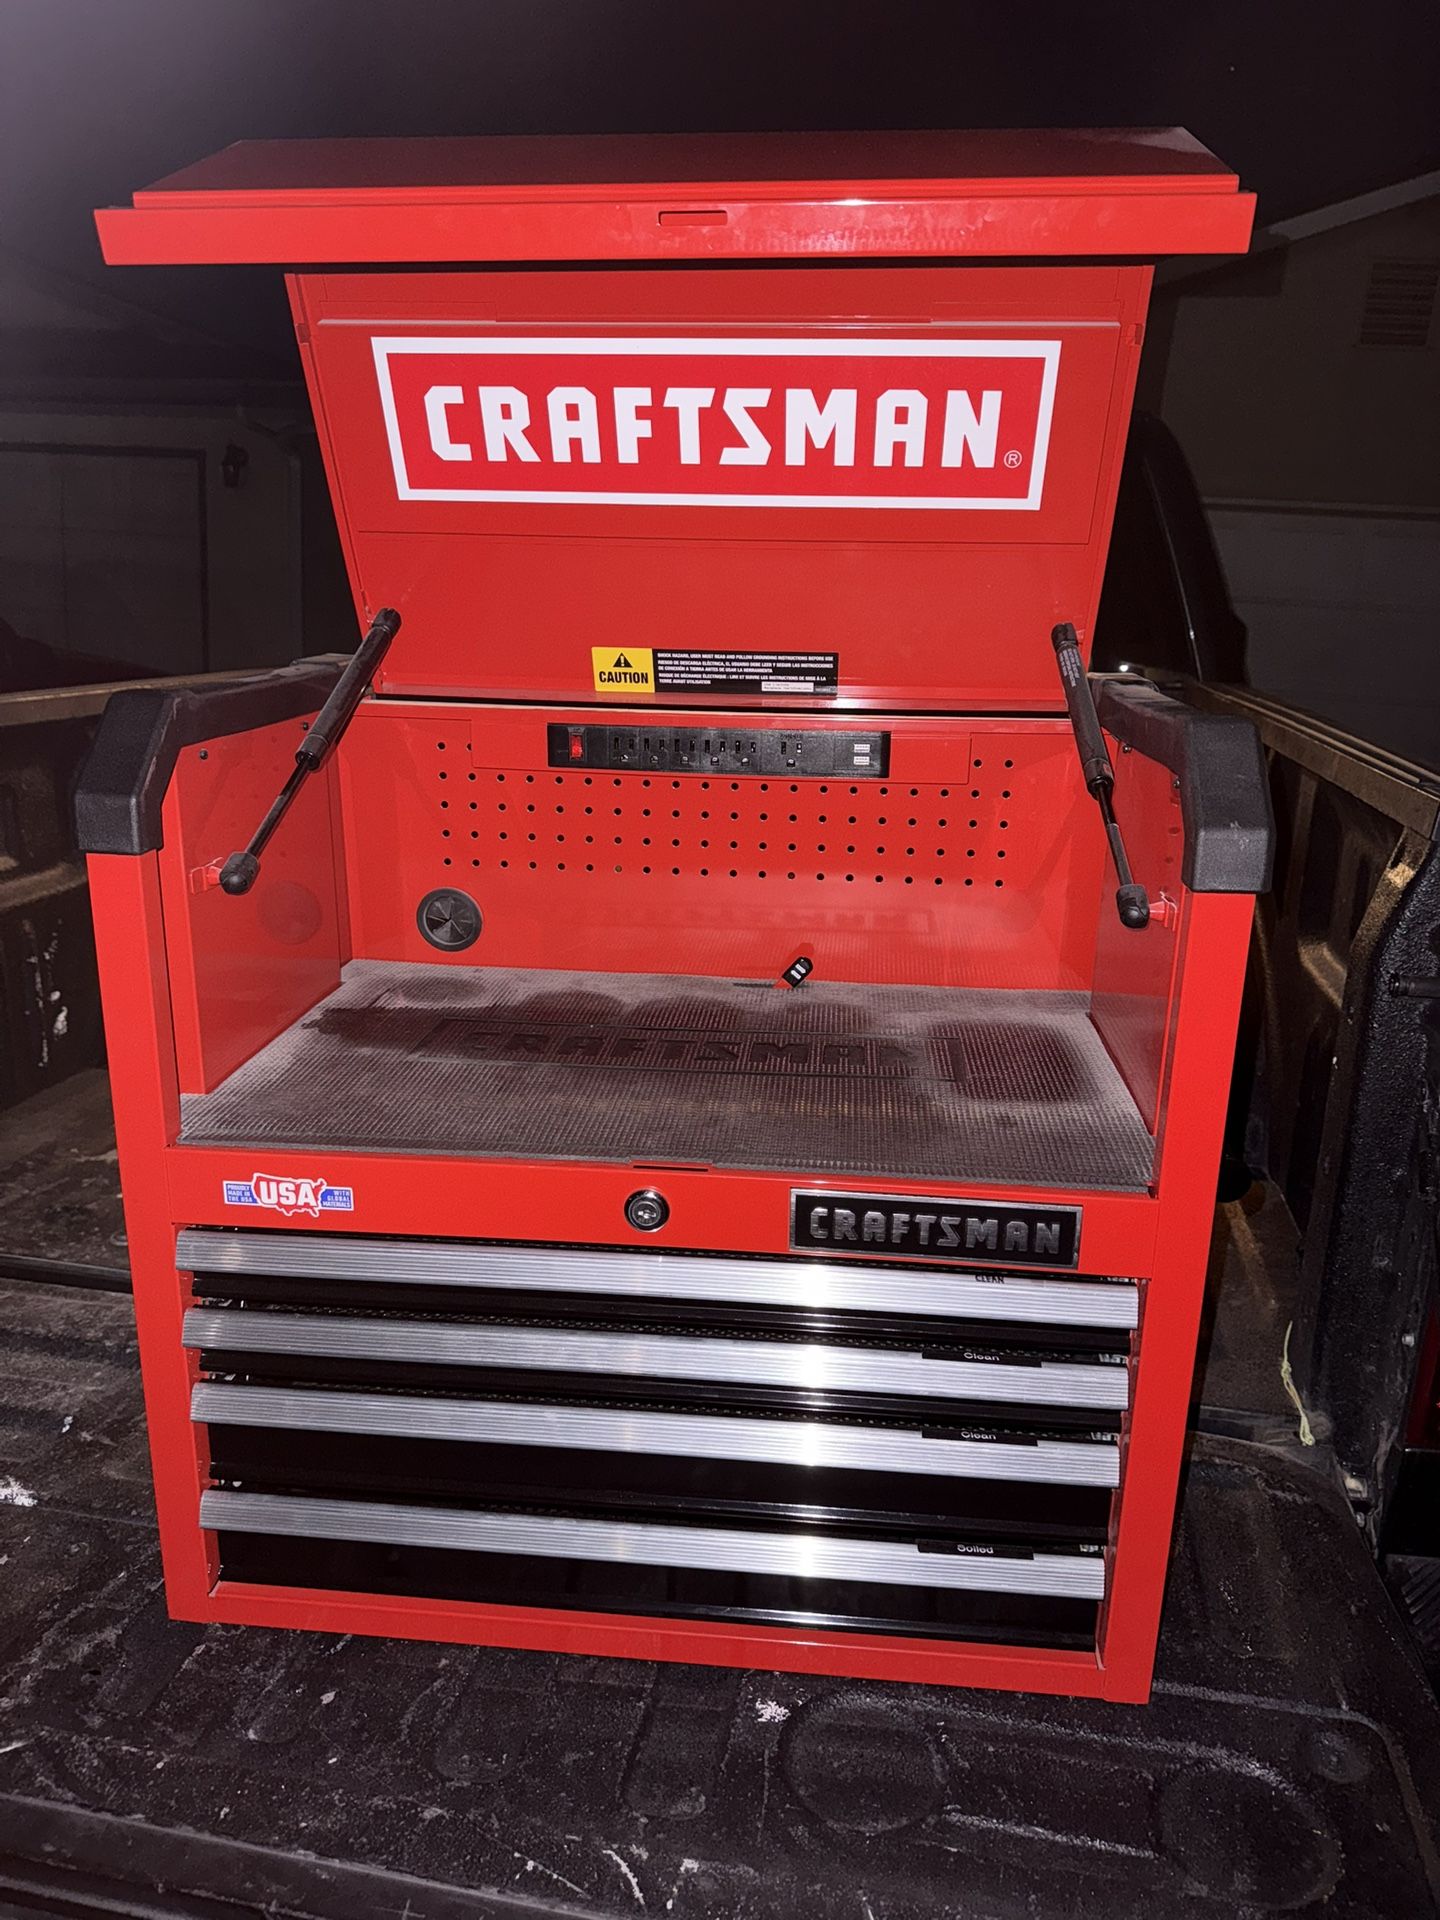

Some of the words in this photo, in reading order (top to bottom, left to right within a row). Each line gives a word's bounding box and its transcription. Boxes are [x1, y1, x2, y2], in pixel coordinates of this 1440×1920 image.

[424, 386, 1002, 468] CRAFTSMAN
[599, 671, 648, 684] CAUTION
[459, 1031, 927, 1068] CRAFTSMAN
[259, 1181, 317, 1206] USA
[810, 1206, 1060, 1254] CRAFTSMAN
[975, 1274, 1005, 1284] CLEAN
[964, 1352, 1000, 1361] Clean
[961, 1431, 997, 1440] Clean
